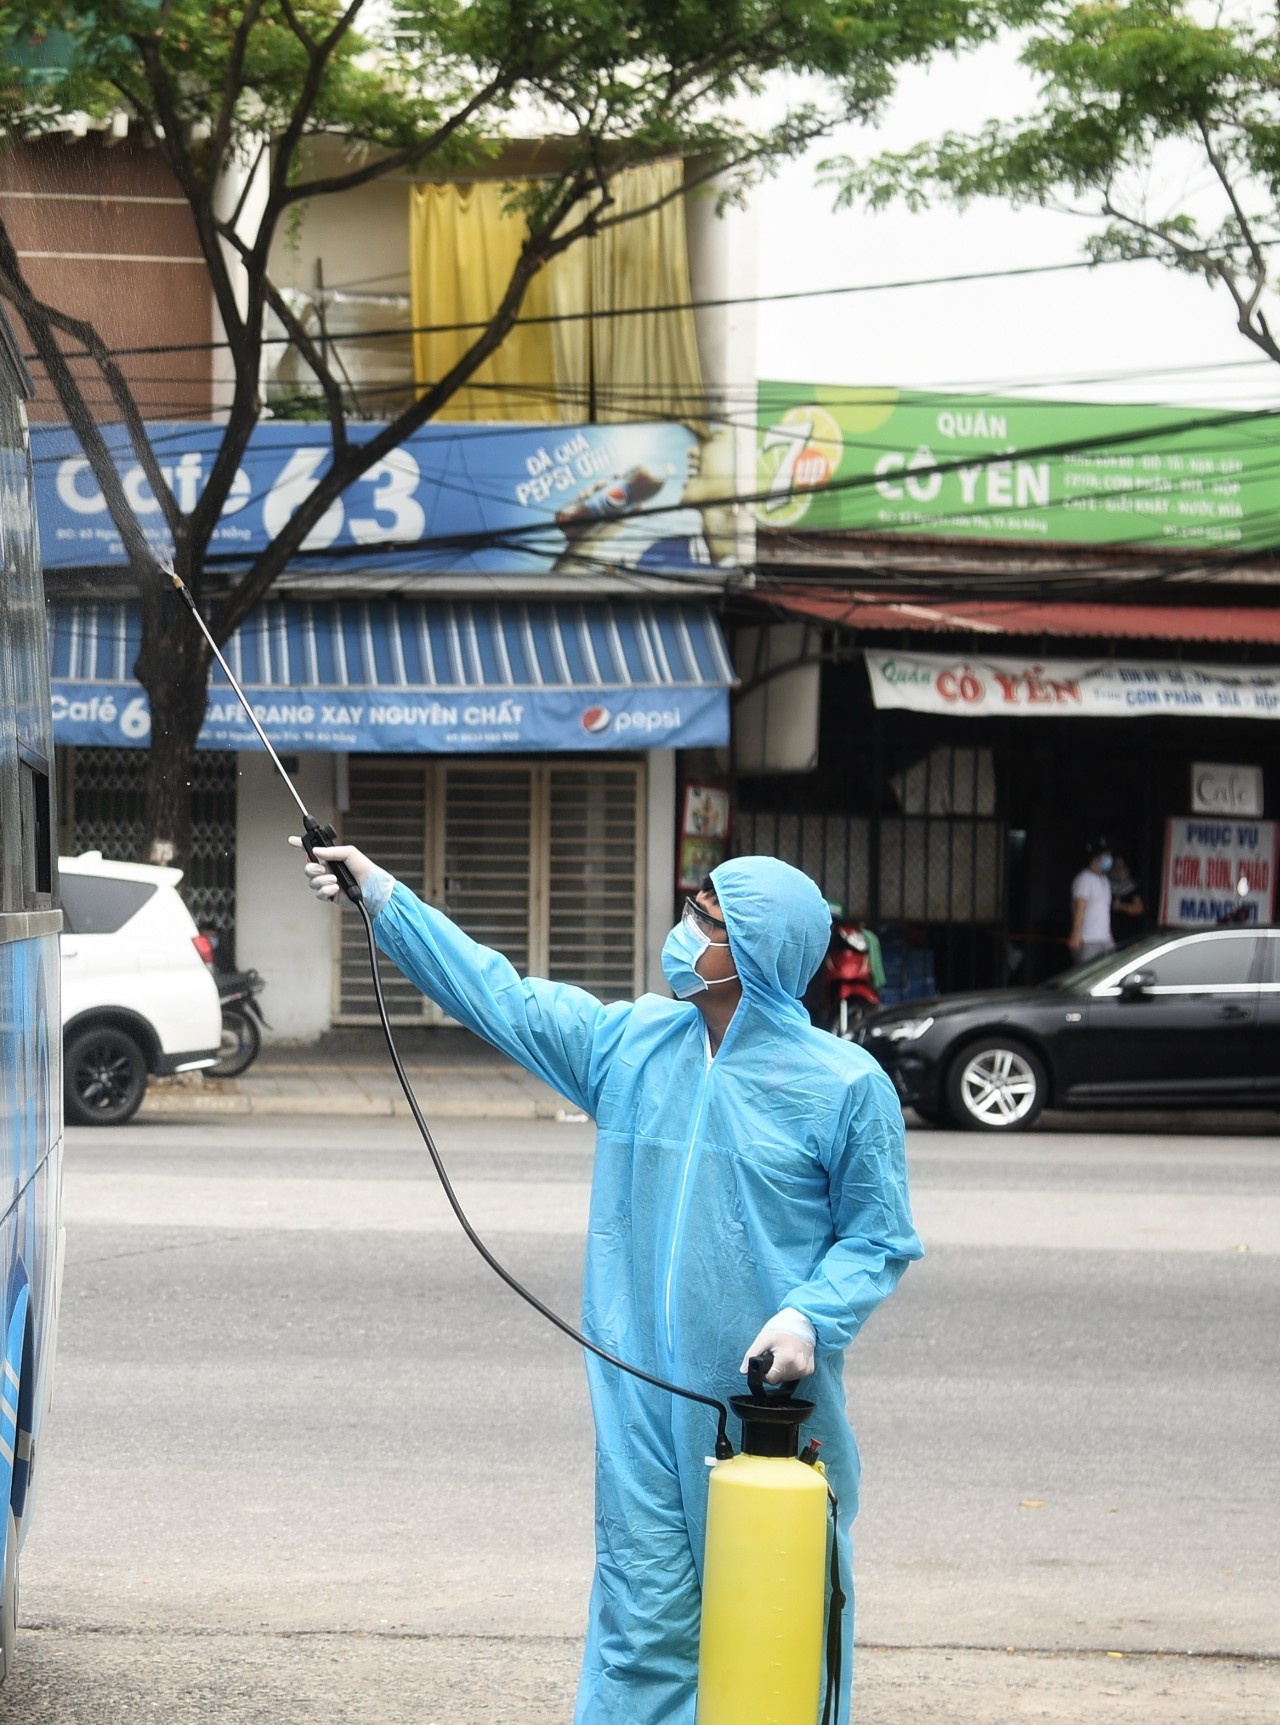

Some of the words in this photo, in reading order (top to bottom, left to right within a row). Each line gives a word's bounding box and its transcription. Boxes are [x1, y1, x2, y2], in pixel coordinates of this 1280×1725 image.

[937, 410, 1007, 441] QUÁN
[515, 463, 577, 507] PEPSI
[874, 444, 944, 503] CÔ
[263, 447, 426, 551] 63
[51, 695, 117, 723] Café
[254, 704, 316, 724] RANG
[320, 705, 363, 725] XAY
[369, 703, 458, 726] NGUYÊN
[463, 699, 524, 726] CHẤT
[614, 708, 681, 733] pepsi
[1187, 823, 1232, 850] PHỤC
[1237, 825, 1259, 852] VỤ
